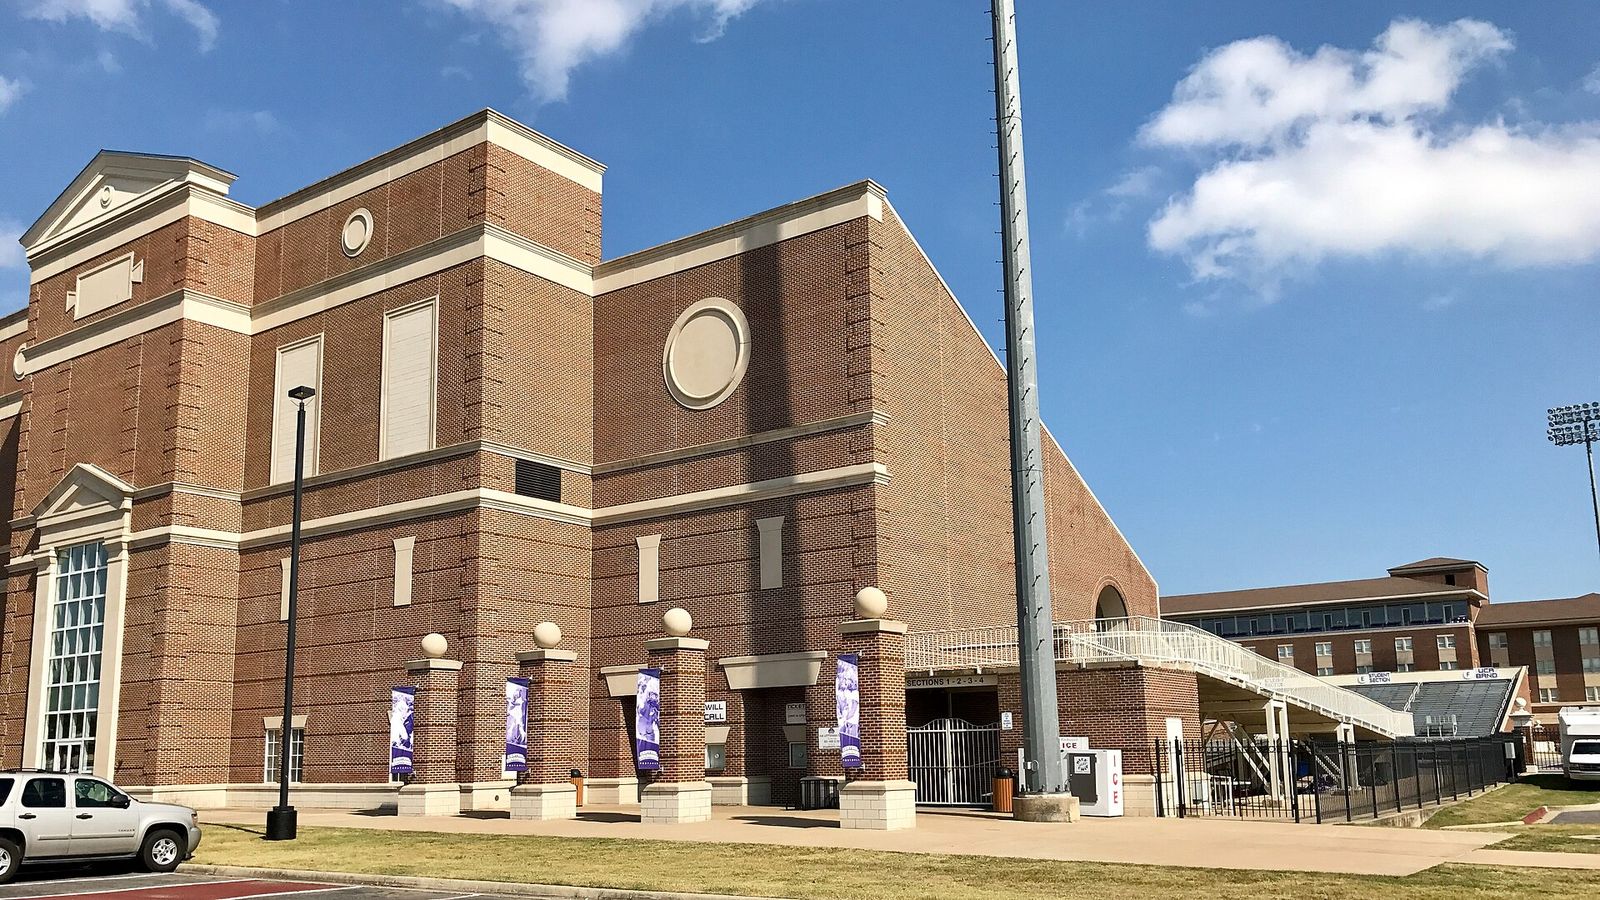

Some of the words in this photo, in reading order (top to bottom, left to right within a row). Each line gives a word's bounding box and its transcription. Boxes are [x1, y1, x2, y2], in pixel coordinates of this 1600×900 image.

[906, 679, 944, 687] SECTIONS
[705, 703, 724, 711] WILL
[704, 713, 725, 721] CALL
